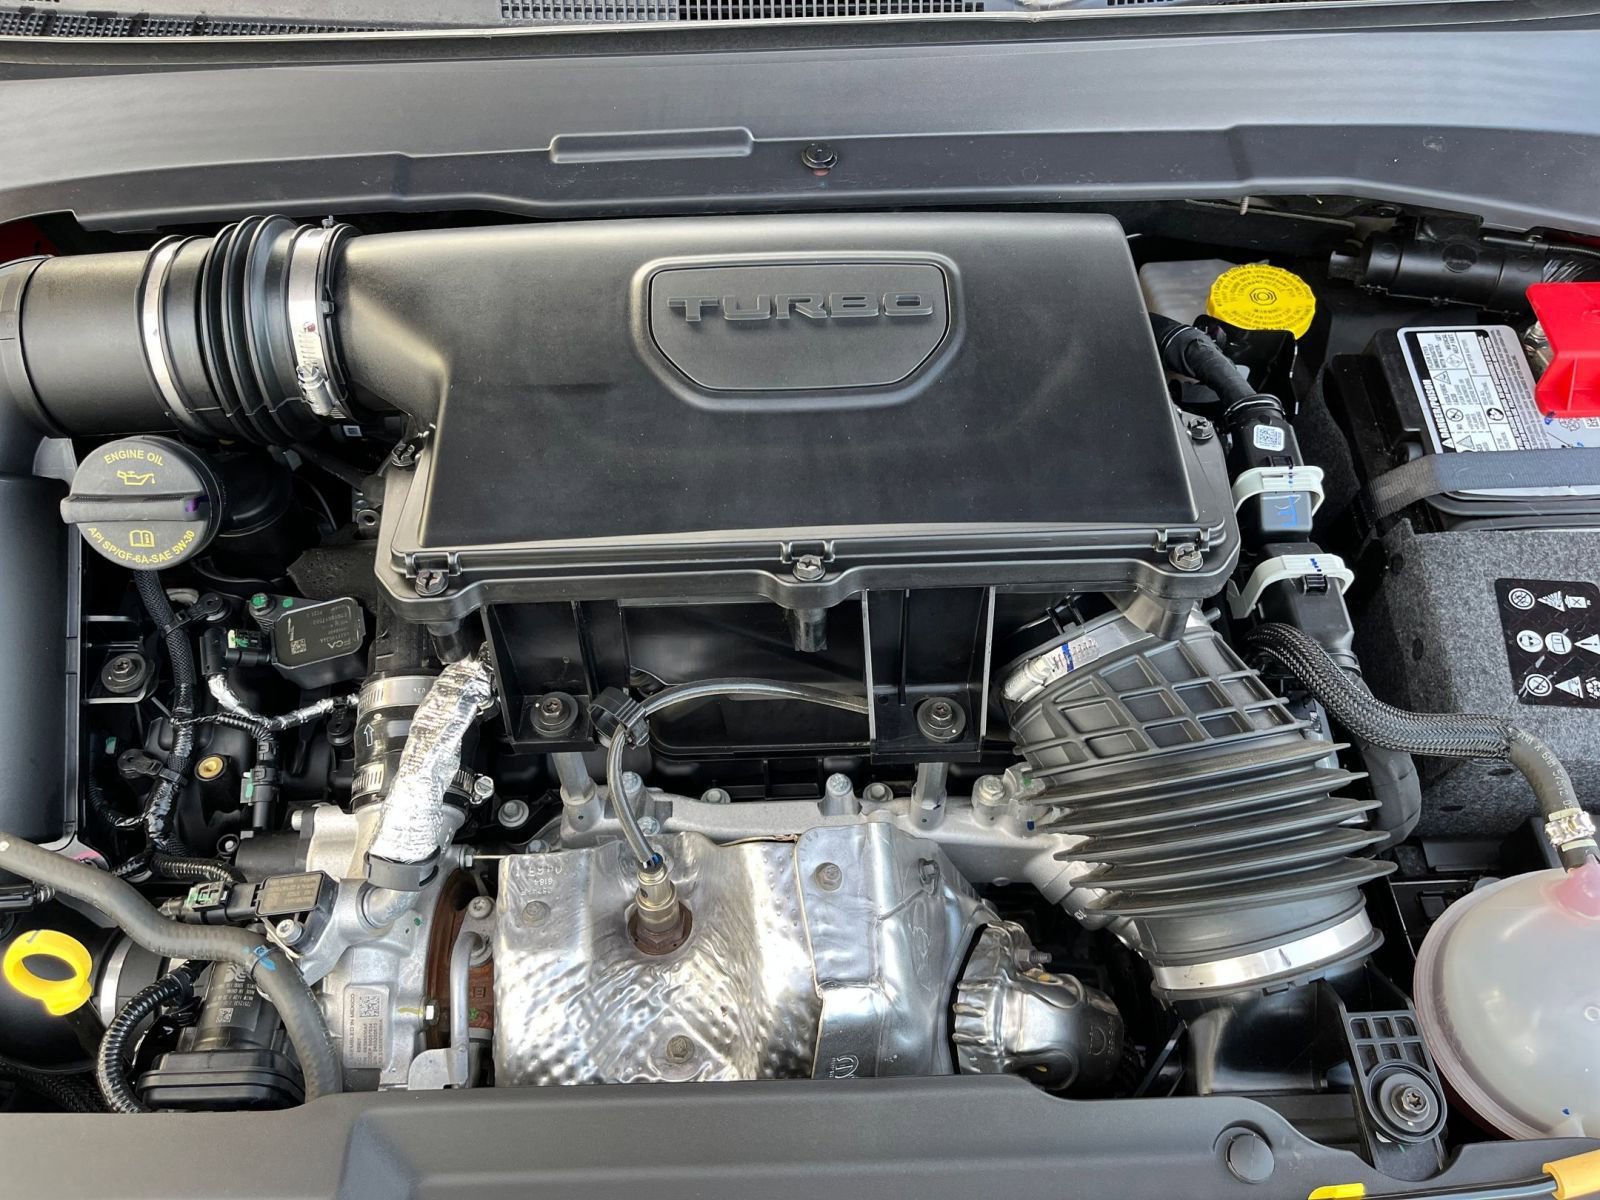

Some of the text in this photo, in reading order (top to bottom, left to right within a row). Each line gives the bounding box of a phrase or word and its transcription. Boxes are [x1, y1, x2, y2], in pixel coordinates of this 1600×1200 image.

[667, 292, 933, 322] TURBO
[104, 450, 164, 466] ENGINE OIL
[88, 527, 105, 546] API
